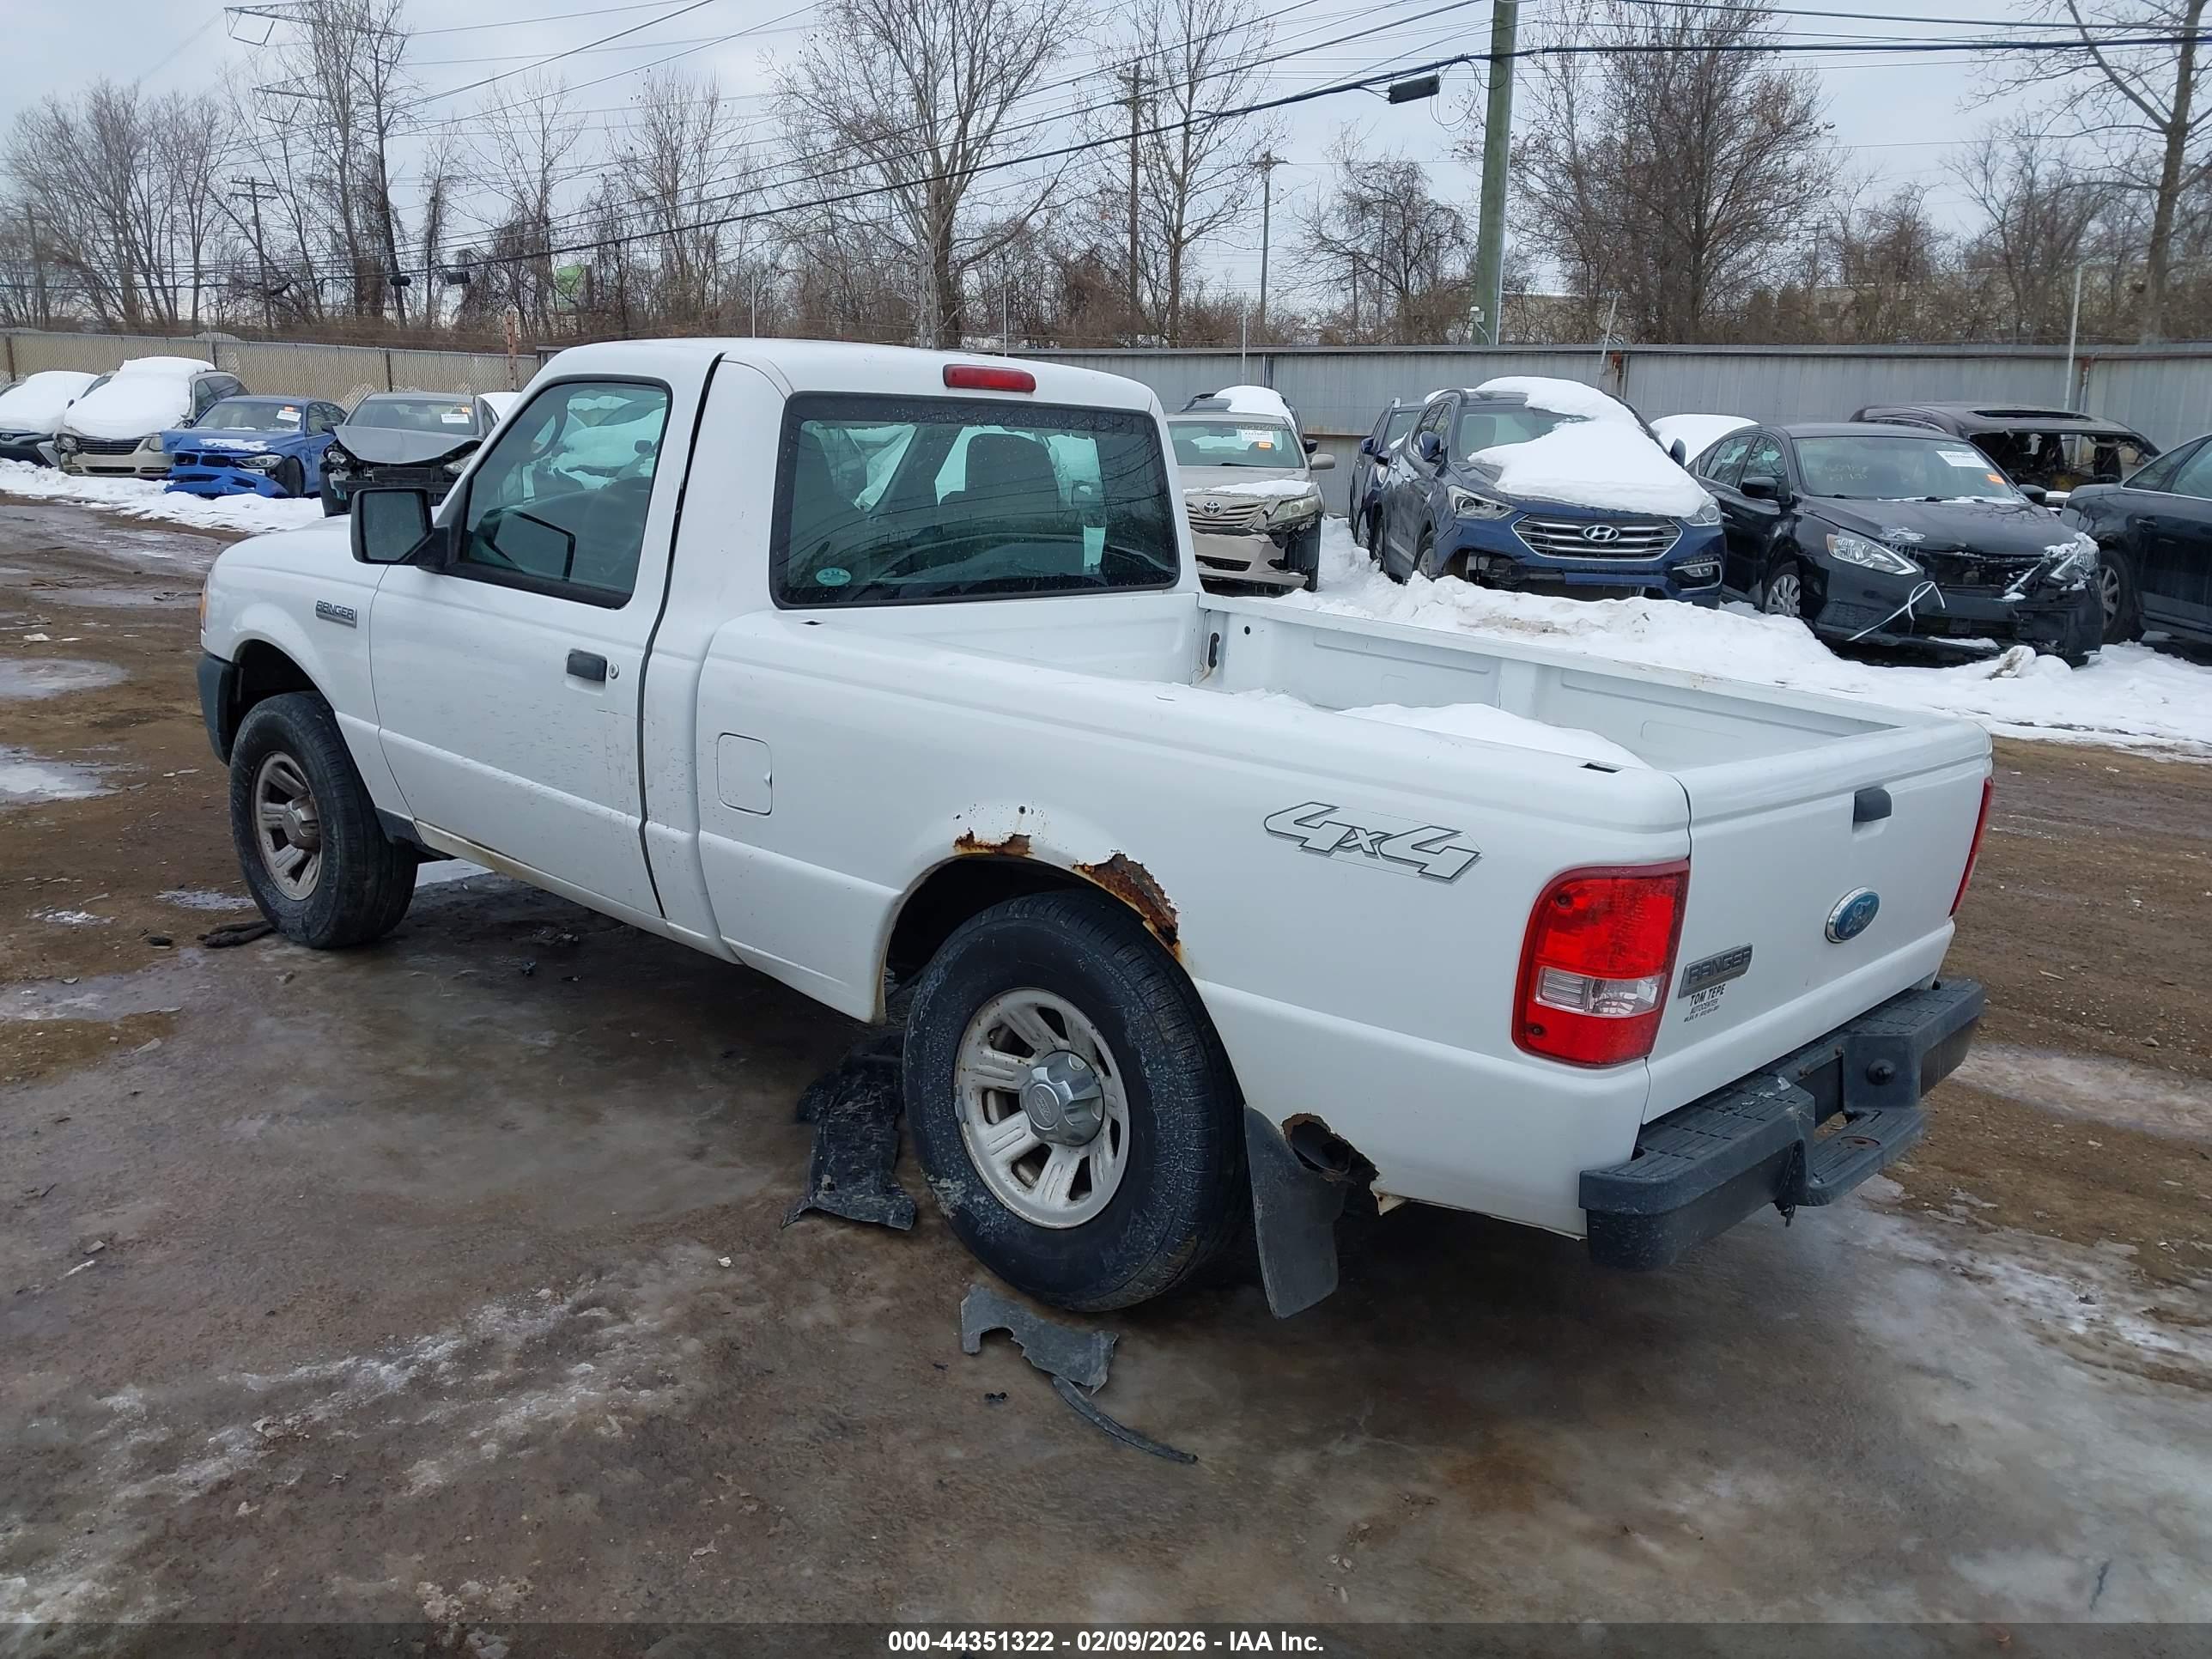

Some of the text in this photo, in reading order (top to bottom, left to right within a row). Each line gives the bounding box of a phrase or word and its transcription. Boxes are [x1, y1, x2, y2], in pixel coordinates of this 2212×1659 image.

[315, 599, 355, 621] RANGER
[1264, 802, 1484, 884] 4x4
[1688, 947, 1753, 985] RANGER
[1689, 982, 1727, 1007] TOM TEPE
